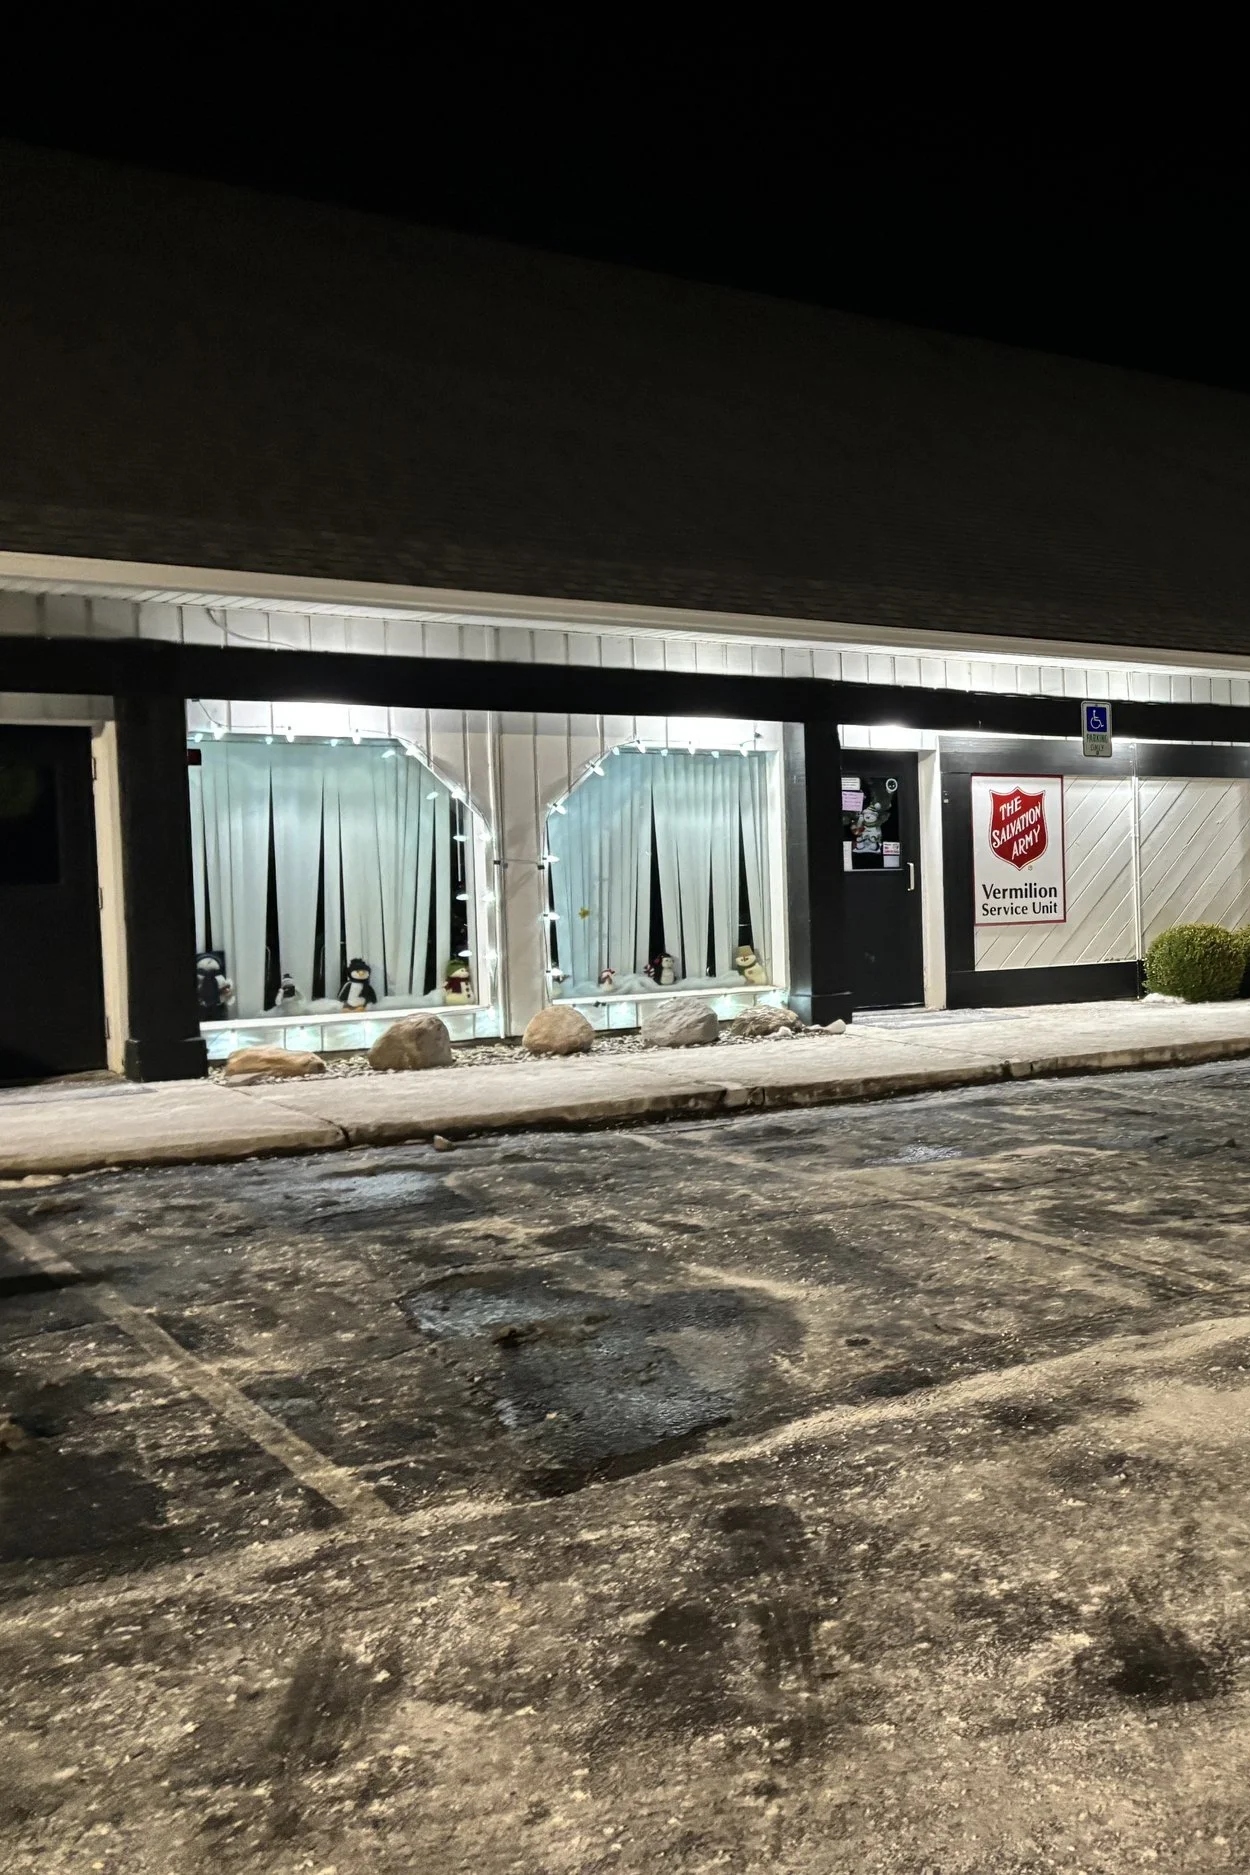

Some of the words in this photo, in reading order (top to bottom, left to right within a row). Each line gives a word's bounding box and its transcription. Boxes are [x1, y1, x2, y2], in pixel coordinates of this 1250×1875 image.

[1000, 796, 1022, 821] THE
[992, 801, 1041, 848] SALVATION
[1012, 825, 1041, 860] ARMY
[982, 883, 1057, 900] Vermilion
[982, 902, 1028, 916] Service
[1032, 901, 1058, 914] Unit
